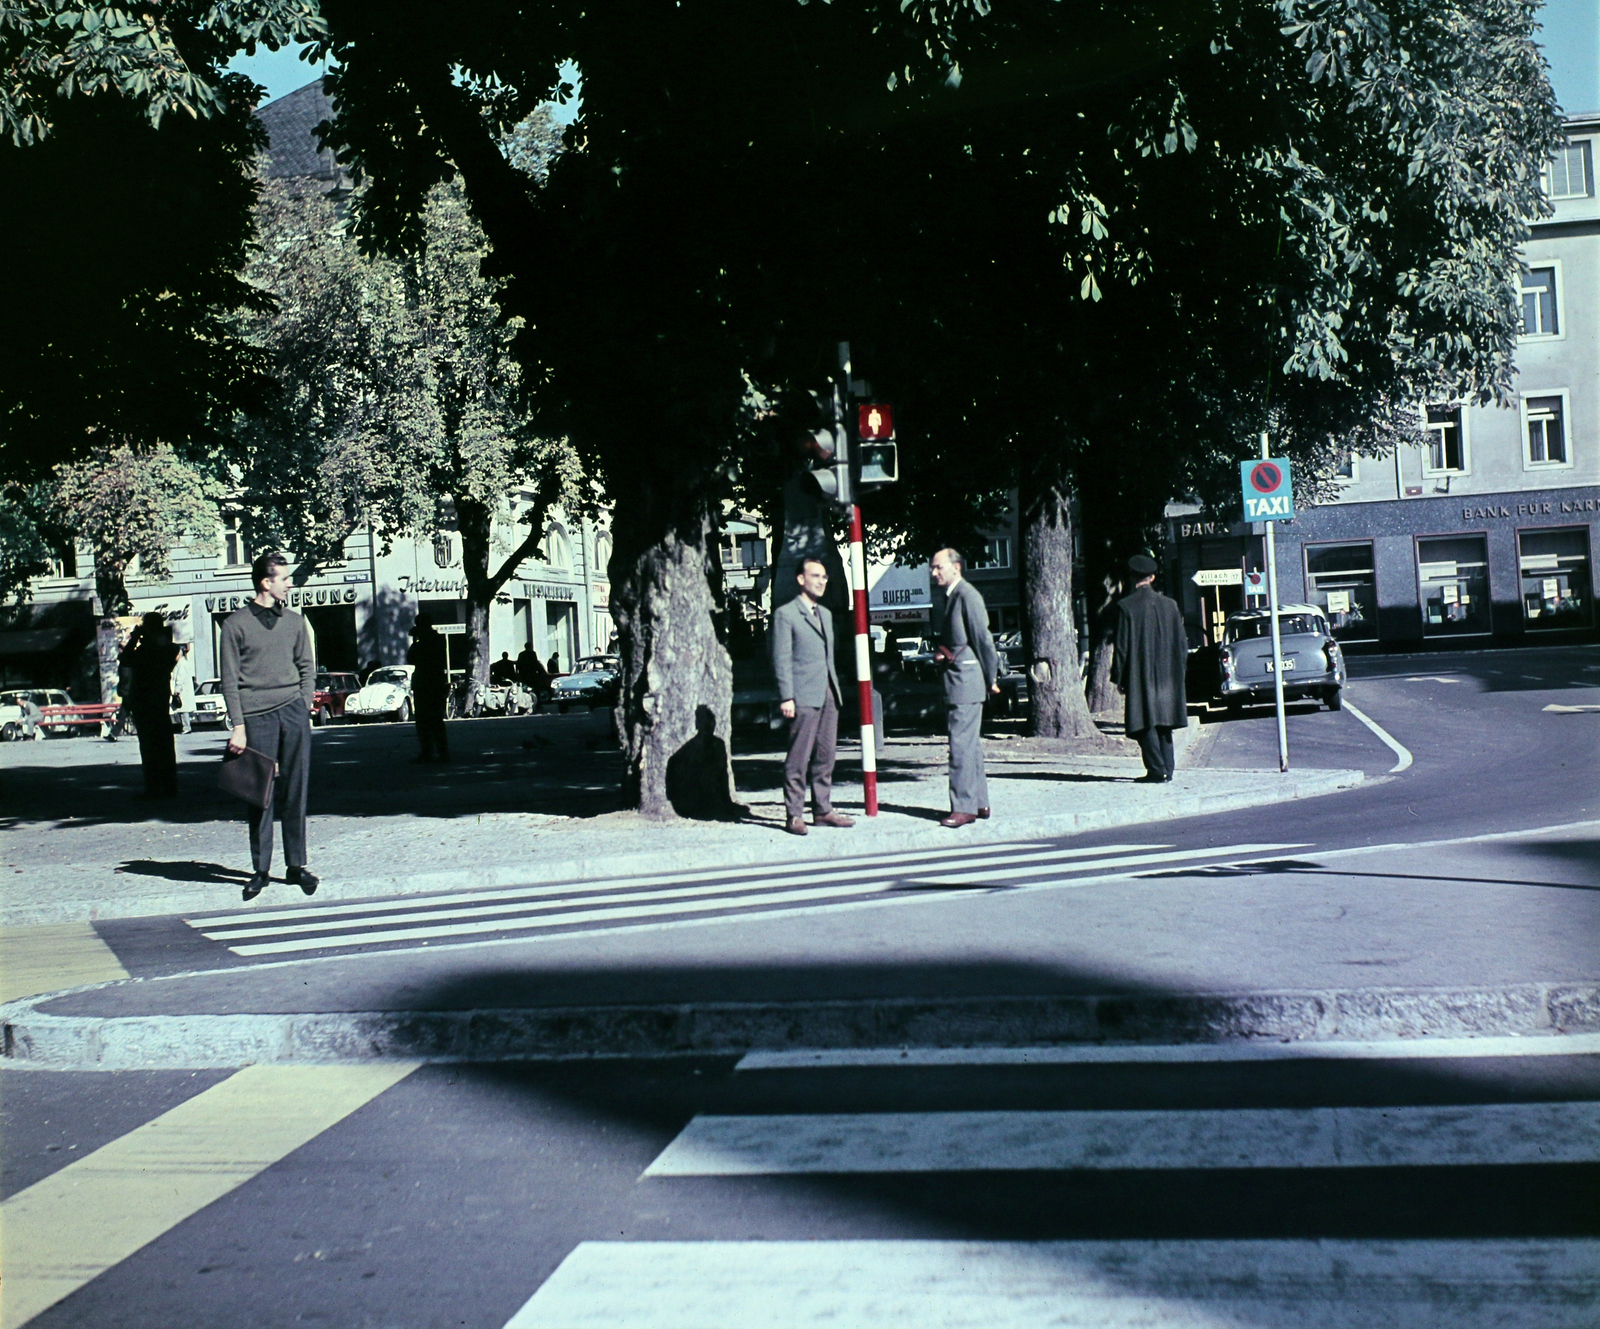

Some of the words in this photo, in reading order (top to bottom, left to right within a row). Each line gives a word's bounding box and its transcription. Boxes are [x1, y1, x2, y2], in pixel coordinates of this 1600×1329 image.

[1246, 496, 1290, 517] TAXI
[1462, 505, 1510, 520] BANK
[398, 575, 468, 600] Interunf
[1248, 585, 1264, 593] TAXI
[882, 589, 911, 604] BUFFA
[895, 611, 922, 620] Kodak
